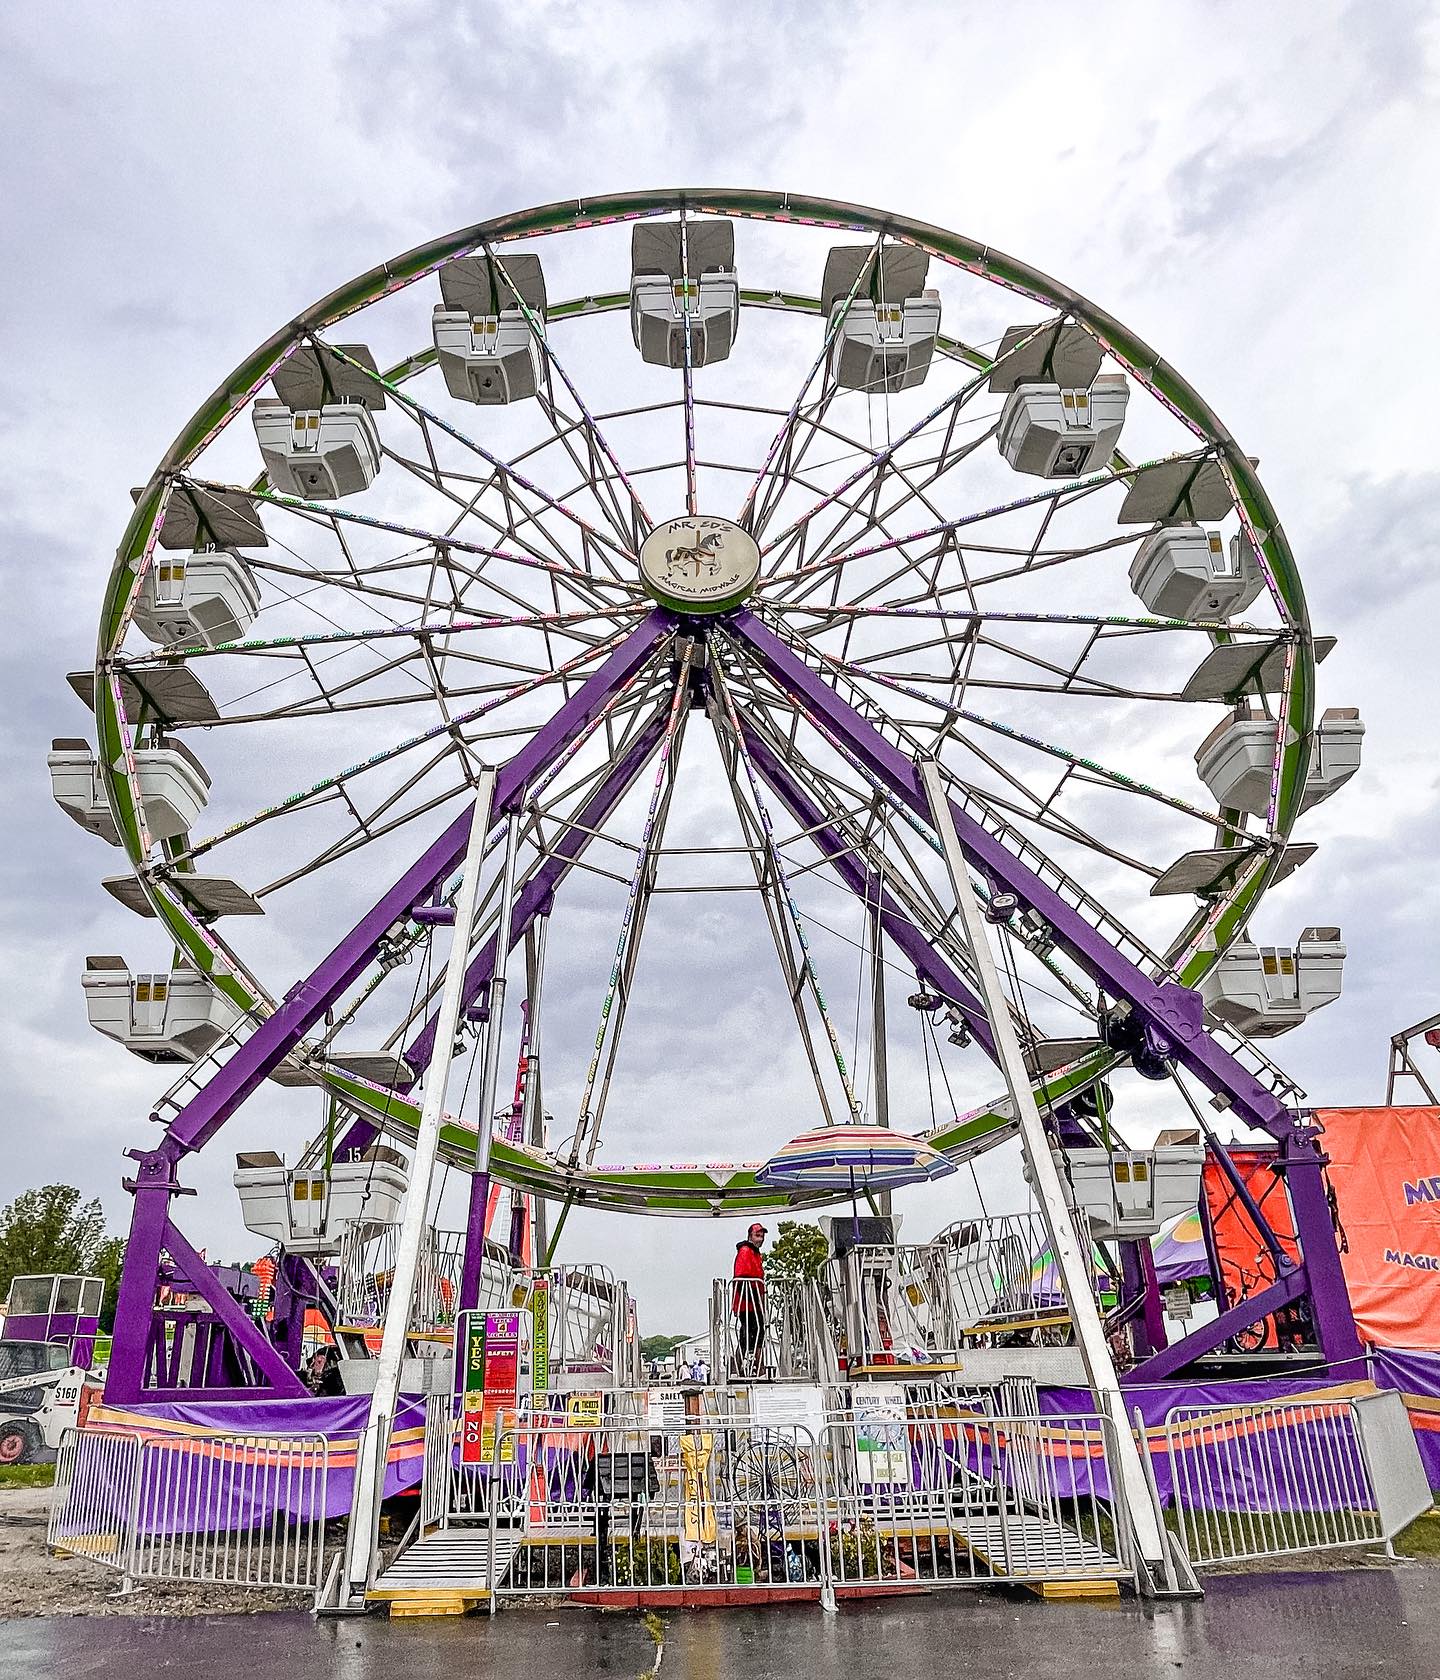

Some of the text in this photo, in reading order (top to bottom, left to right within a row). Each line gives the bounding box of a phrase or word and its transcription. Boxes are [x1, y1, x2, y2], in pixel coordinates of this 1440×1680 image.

[718, 264, 725, 274] 9
[700, 520, 733, 532] ED'S
[205, 542, 216, 554] 12
[657, 574, 697, 594] MAGICAL
[148, 738, 159, 750] 13
[1308, 928, 1320, 941] 4
[347, 1146, 362, 1163] 15
[470, 1336, 483, 1371] YES
[55, 1387, 78, 1400] S160
[855, 1395, 903, 1405] CENTURY WHEEL
[572, 1401, 581, 1413] 4
[466, 1421, 479, 1443] NO
